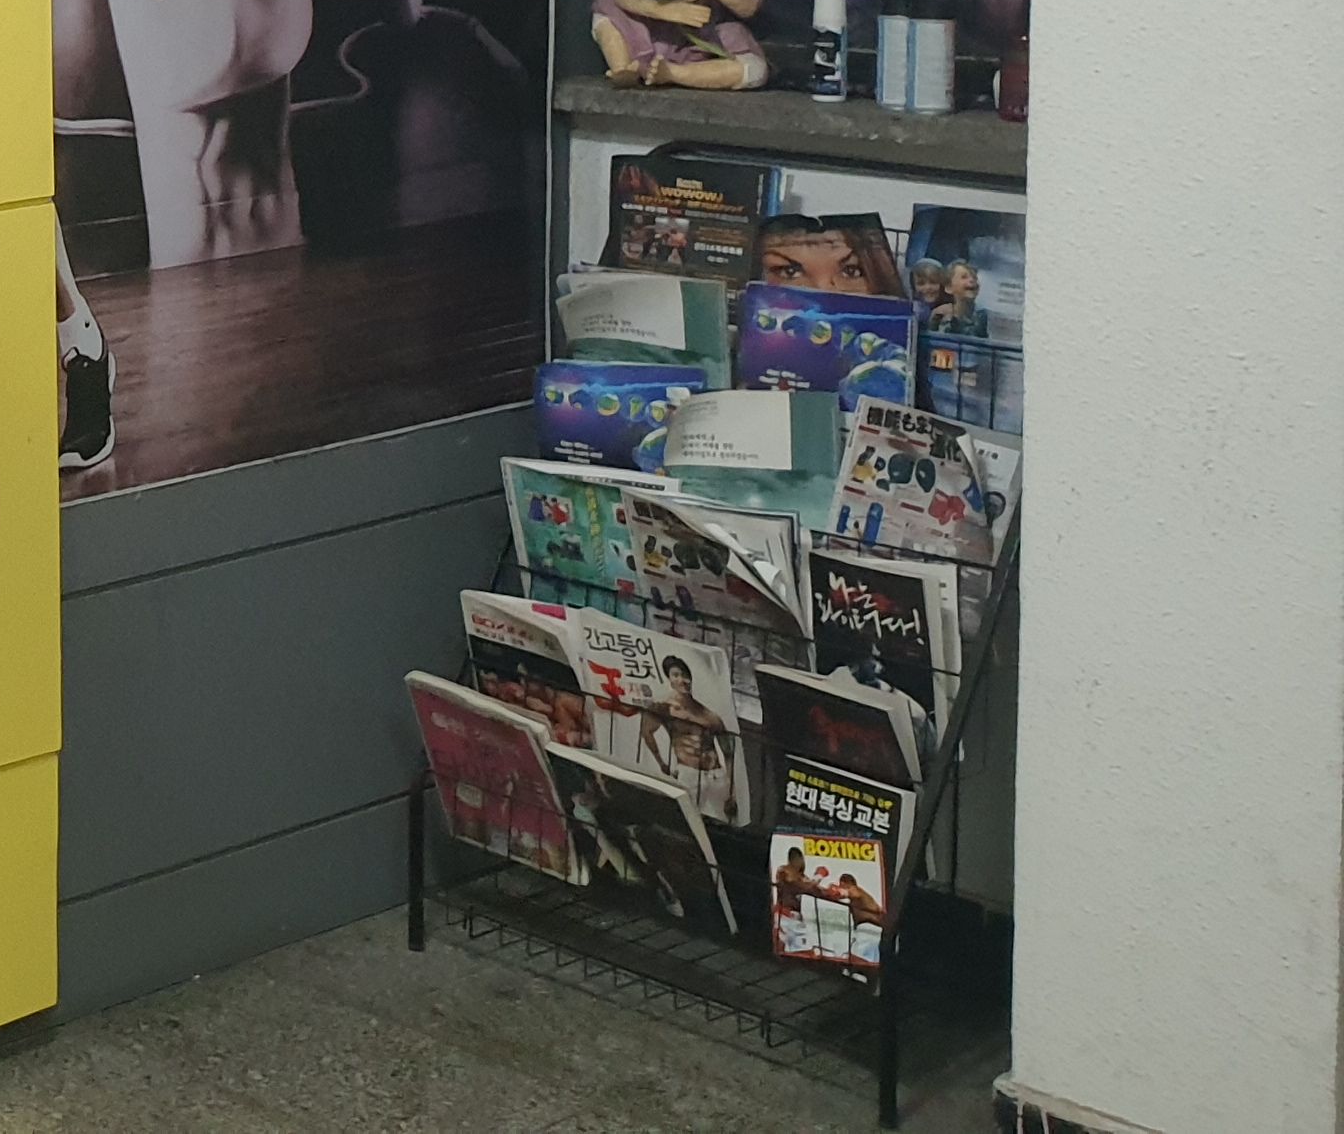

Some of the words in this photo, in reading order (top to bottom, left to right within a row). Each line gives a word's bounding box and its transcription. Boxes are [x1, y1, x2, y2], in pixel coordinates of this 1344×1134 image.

[583, 627, 660, 669] 간고등어
[786, 781, 817, 811] 현대
[819, 792, 853, 822] 복싱
[855, 803, 890, 834] 교본
[805, 839, 876, 861] BOXING
